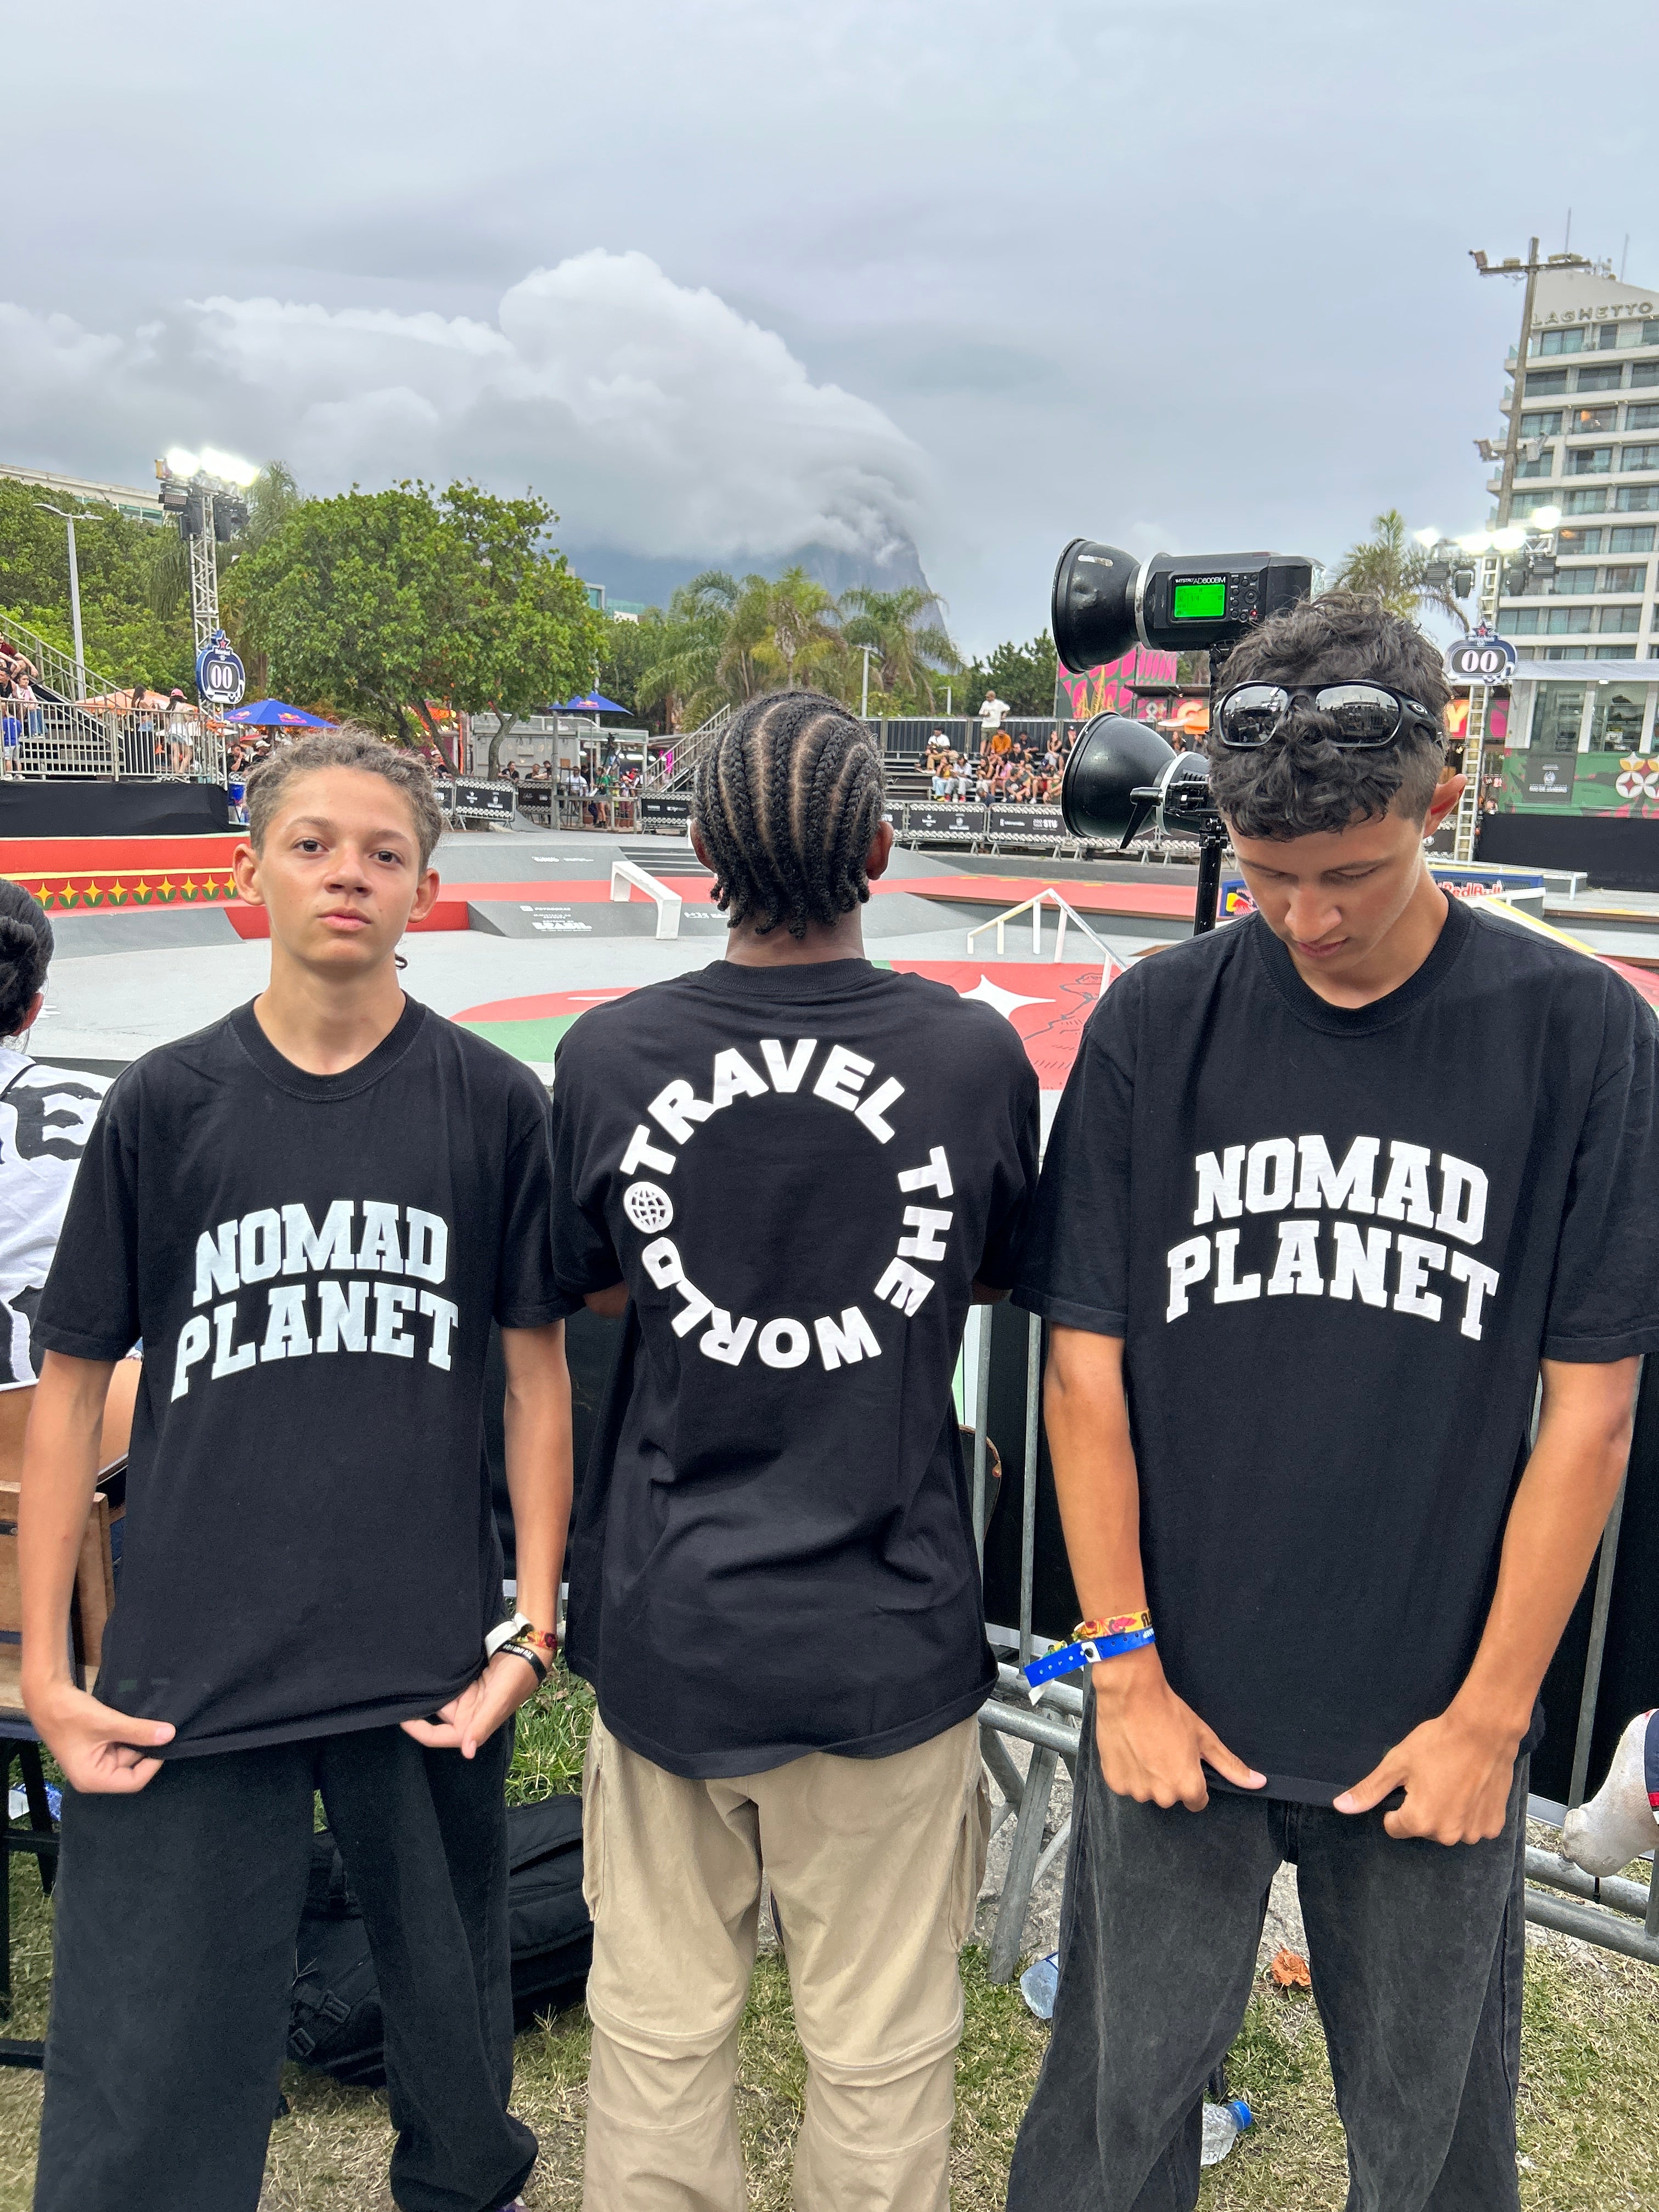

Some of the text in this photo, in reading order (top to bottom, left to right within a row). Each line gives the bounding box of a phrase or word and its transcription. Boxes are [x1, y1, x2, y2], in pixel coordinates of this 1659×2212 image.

[1533, 302, 1653, 325] LAGHETTO
[211, 665, 233, 690] 00
[1462, 650, 1498, 673] 00
[619, 1039, 953, 1371] TRAVEL THE WORLD
[1194, 1135, 1488, 1246] NOMAD
[193, 1200, 448, 1307] NOMAD
[1166, 1220, 1500, 1341] PLANET
[171, 1281, 459, 1403] PLANET
